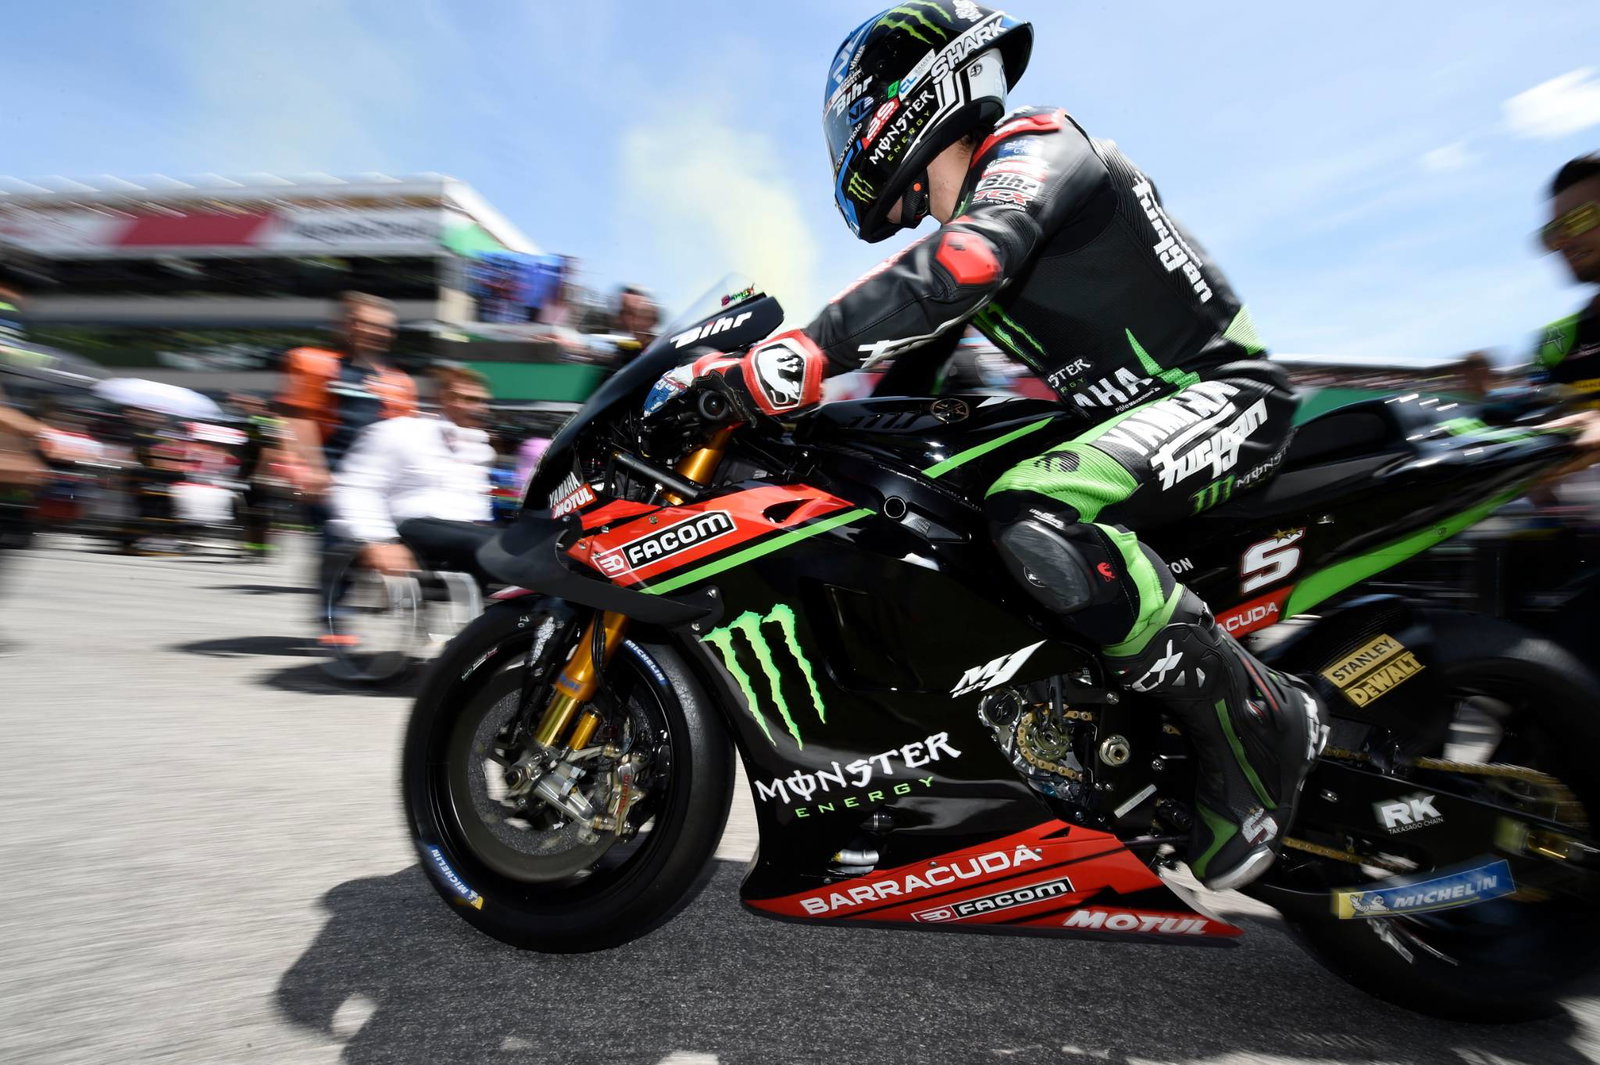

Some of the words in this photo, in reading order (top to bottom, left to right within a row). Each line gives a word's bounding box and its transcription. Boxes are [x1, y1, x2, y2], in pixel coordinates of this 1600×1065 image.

[931, 17, 1009, 85] SHARK
[869, 90, 935, 165] MONSTER
[887, 110, 931, 161] ENERGY
[669, 311, 753, 349] Bihr
[549, 471, 581, 509] YAMAHA
[552, 487, 594, 519] MOTUL
[628, 512, 728, 564] FACOM
[625, 639, 665, 681] MICHELIN
[1332, 639, 1394, 682] STANLEY
[1347, 652, 1423, 705] DEWALT
[754, 731, 962, 804] MONSTER
[795, 776, 934, 818] ENERGY
[1381, 795, 1442, 828] RK
[1388, 822, 1423, 835] TAKASAGO
[1423, 817, 1444, 827] CHAIN
[432, 849, 469, 894] MICHELIN
[800, 844, 1043, 915] BARRACUDA
[1394, 875, 1498, 908] MICHELIN
[958, 881, 1066, 915] FACOM
[1063, 909, 1209, 934] MOTUL
